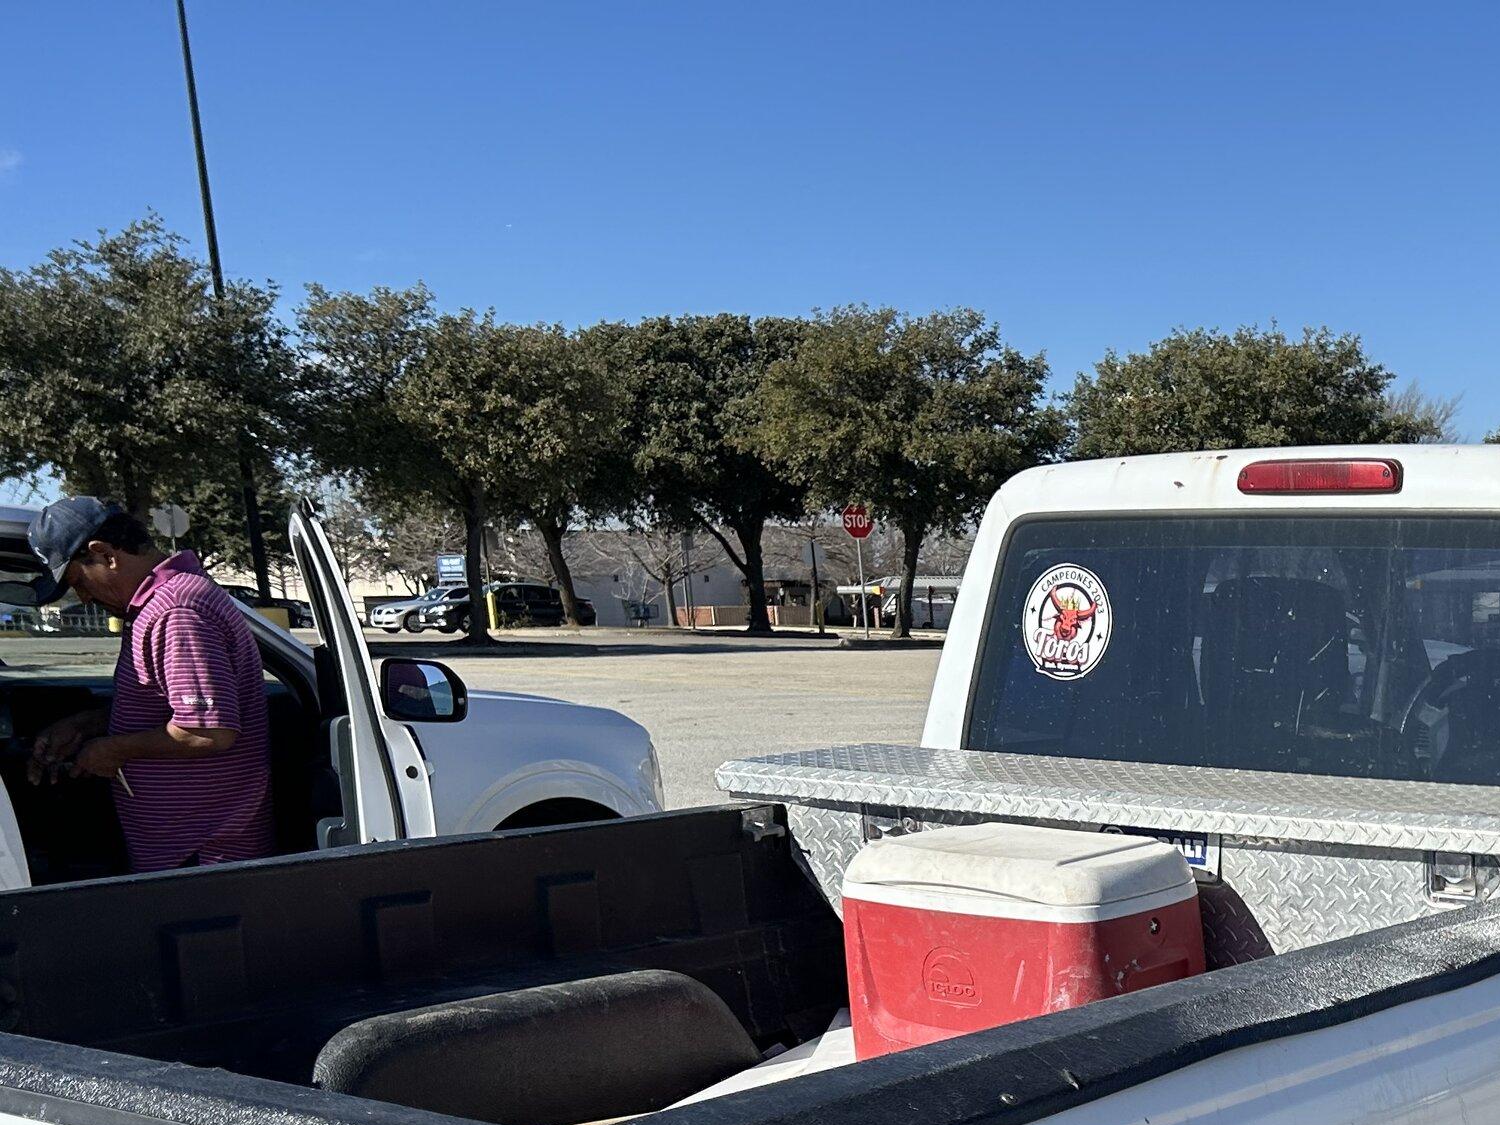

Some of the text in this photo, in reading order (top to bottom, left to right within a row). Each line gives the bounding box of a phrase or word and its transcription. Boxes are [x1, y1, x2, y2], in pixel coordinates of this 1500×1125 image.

[844, 514, 871, 528] STOP
[1041, 570, 1105, 614] CAMPEONES 2023
[1033, 627, 1090, 665] Toros
